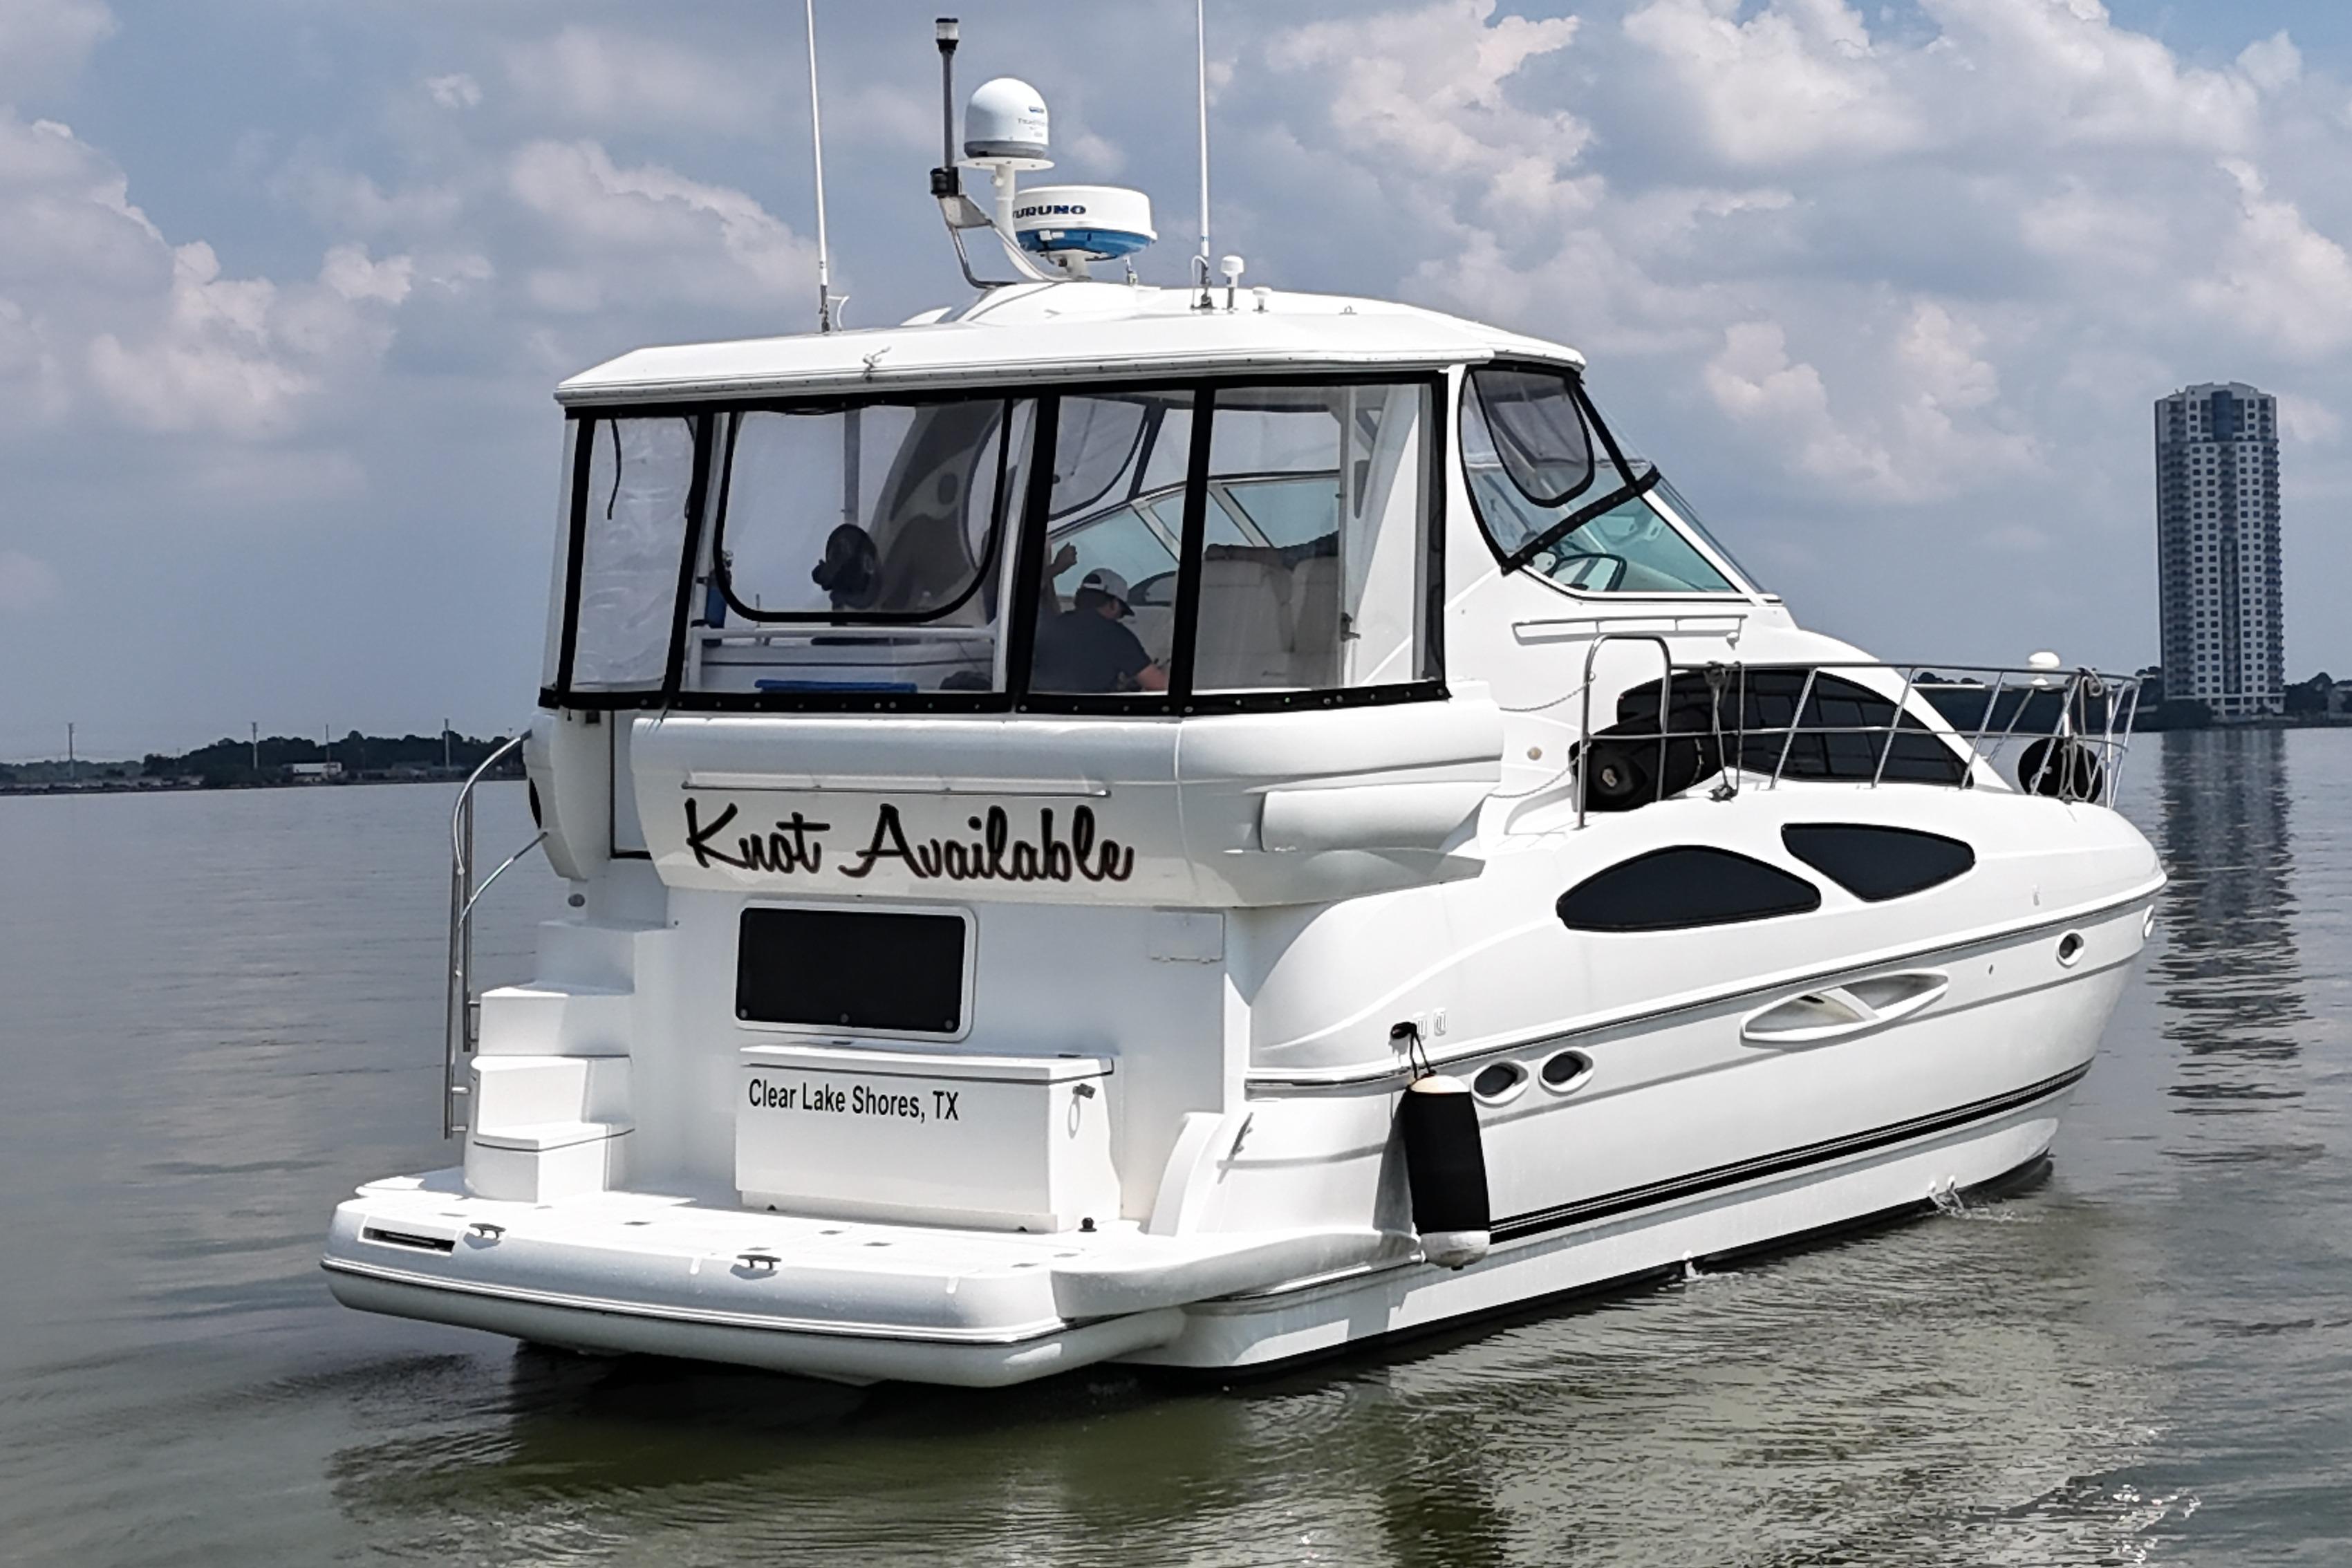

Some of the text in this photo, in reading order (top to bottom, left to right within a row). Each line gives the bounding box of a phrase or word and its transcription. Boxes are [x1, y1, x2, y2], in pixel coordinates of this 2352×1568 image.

[684, 797, 1135, 883] Knot Available
[749, 1079, 959, 1123] Clear Lake Shores, TX
